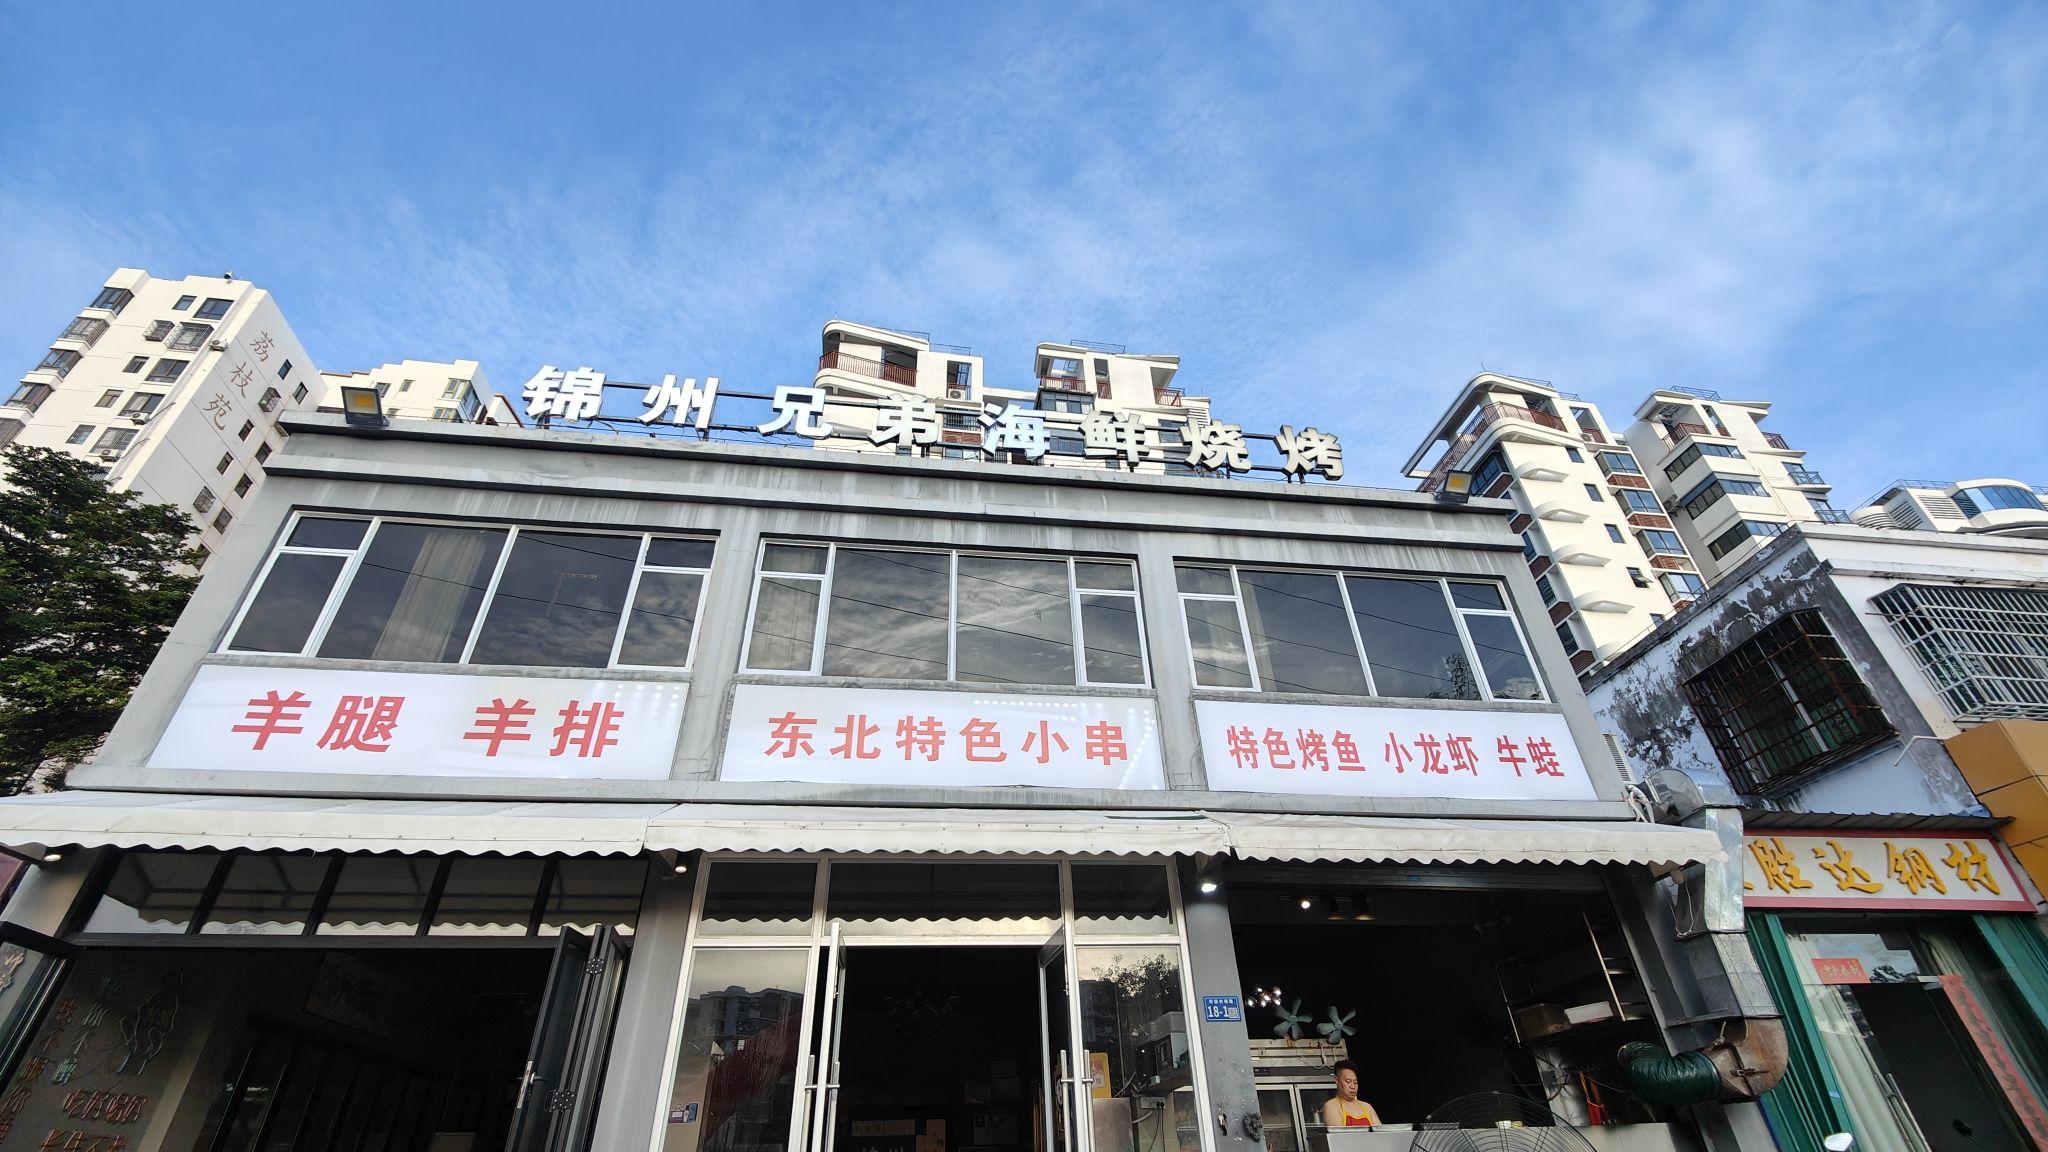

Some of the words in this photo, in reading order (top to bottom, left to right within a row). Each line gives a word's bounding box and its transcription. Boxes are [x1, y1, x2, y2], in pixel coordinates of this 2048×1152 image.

[203, 330, 274, 430] 荔枝苑
[522, 364, 1343, 481] 锦州兄弟海鲜烧烤
[231, 691, 405, 752] 羊腿
[463, 698, 625, 757] 羊排
[764, 711, 1129, 766] 东北特色小串
[1226, 725, 1366, 772] 特色烤鱼
[1384, 731, 1479, 777] 小龙虾
[1496, 734, 1565, 778] 牛蛙
[1743, 838, 2000, 895] 胜达钢材
[1207, 1005, 1229, 1018] 18-1
